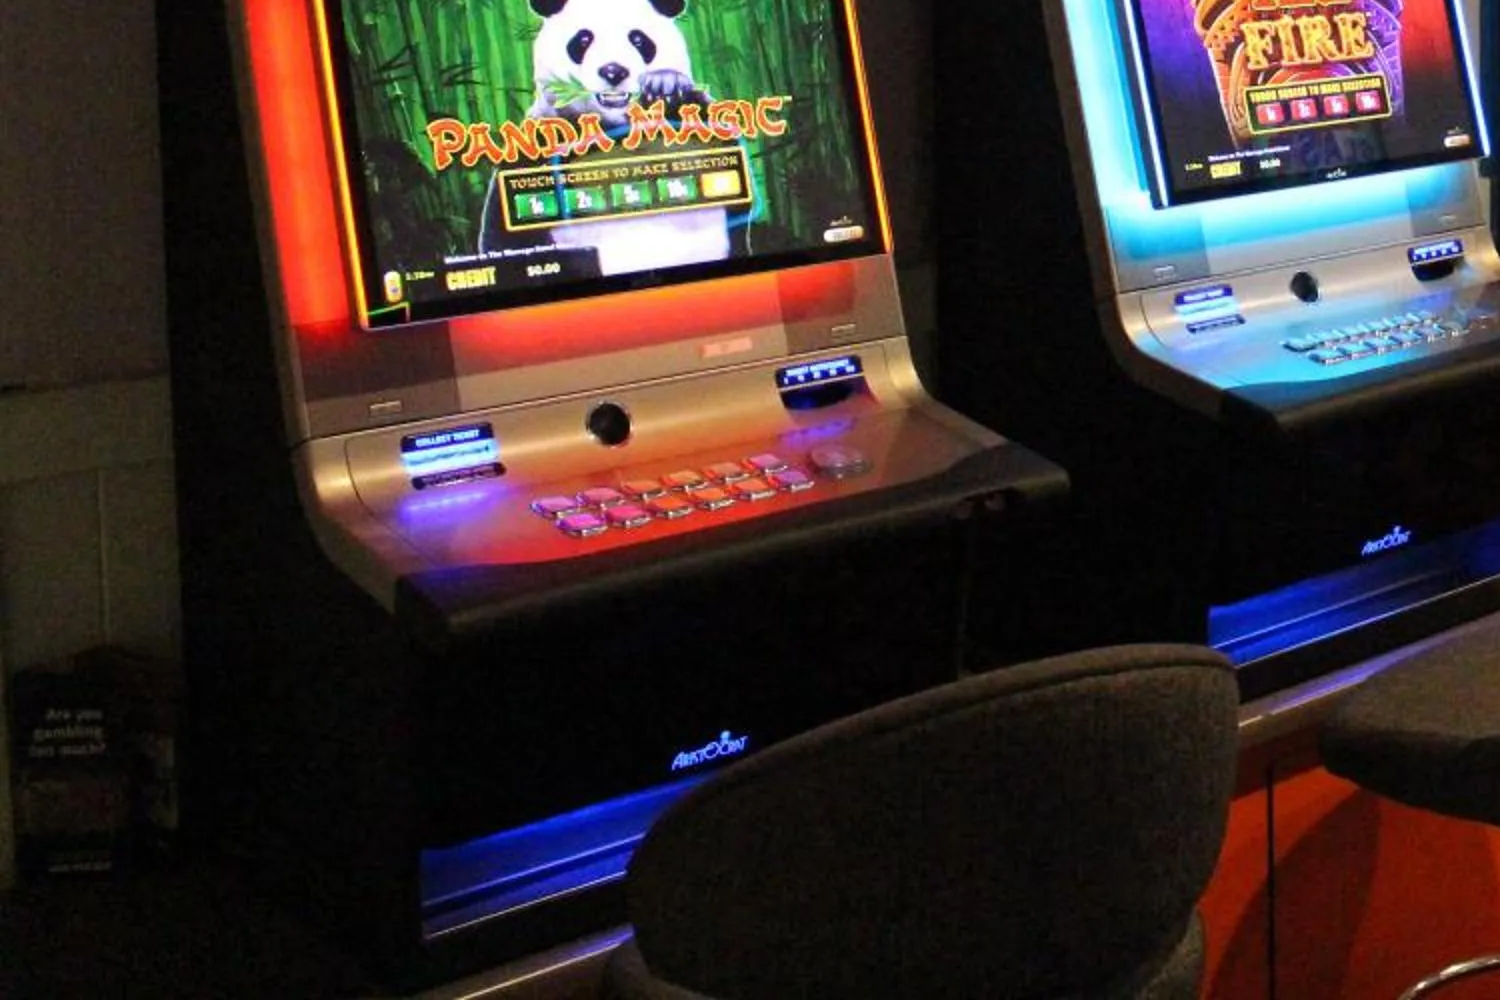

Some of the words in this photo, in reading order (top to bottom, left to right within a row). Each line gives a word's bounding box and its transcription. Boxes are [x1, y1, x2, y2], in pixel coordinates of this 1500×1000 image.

[1240, 13, 1375, 70] FIRE
[425, 109, 613, 170] PANDA
[621, 96, 789, 149] MAGIC
[509, 175, 554, 189] TOUCH
[559, 169, 609, 184] SCREEN
[612, 167, 629, 178] TO
[632, 163, 669, 177] MAKE
[672, 155, 739, 172] SELECTION
[446, 266, 497, 290] CREDIT
